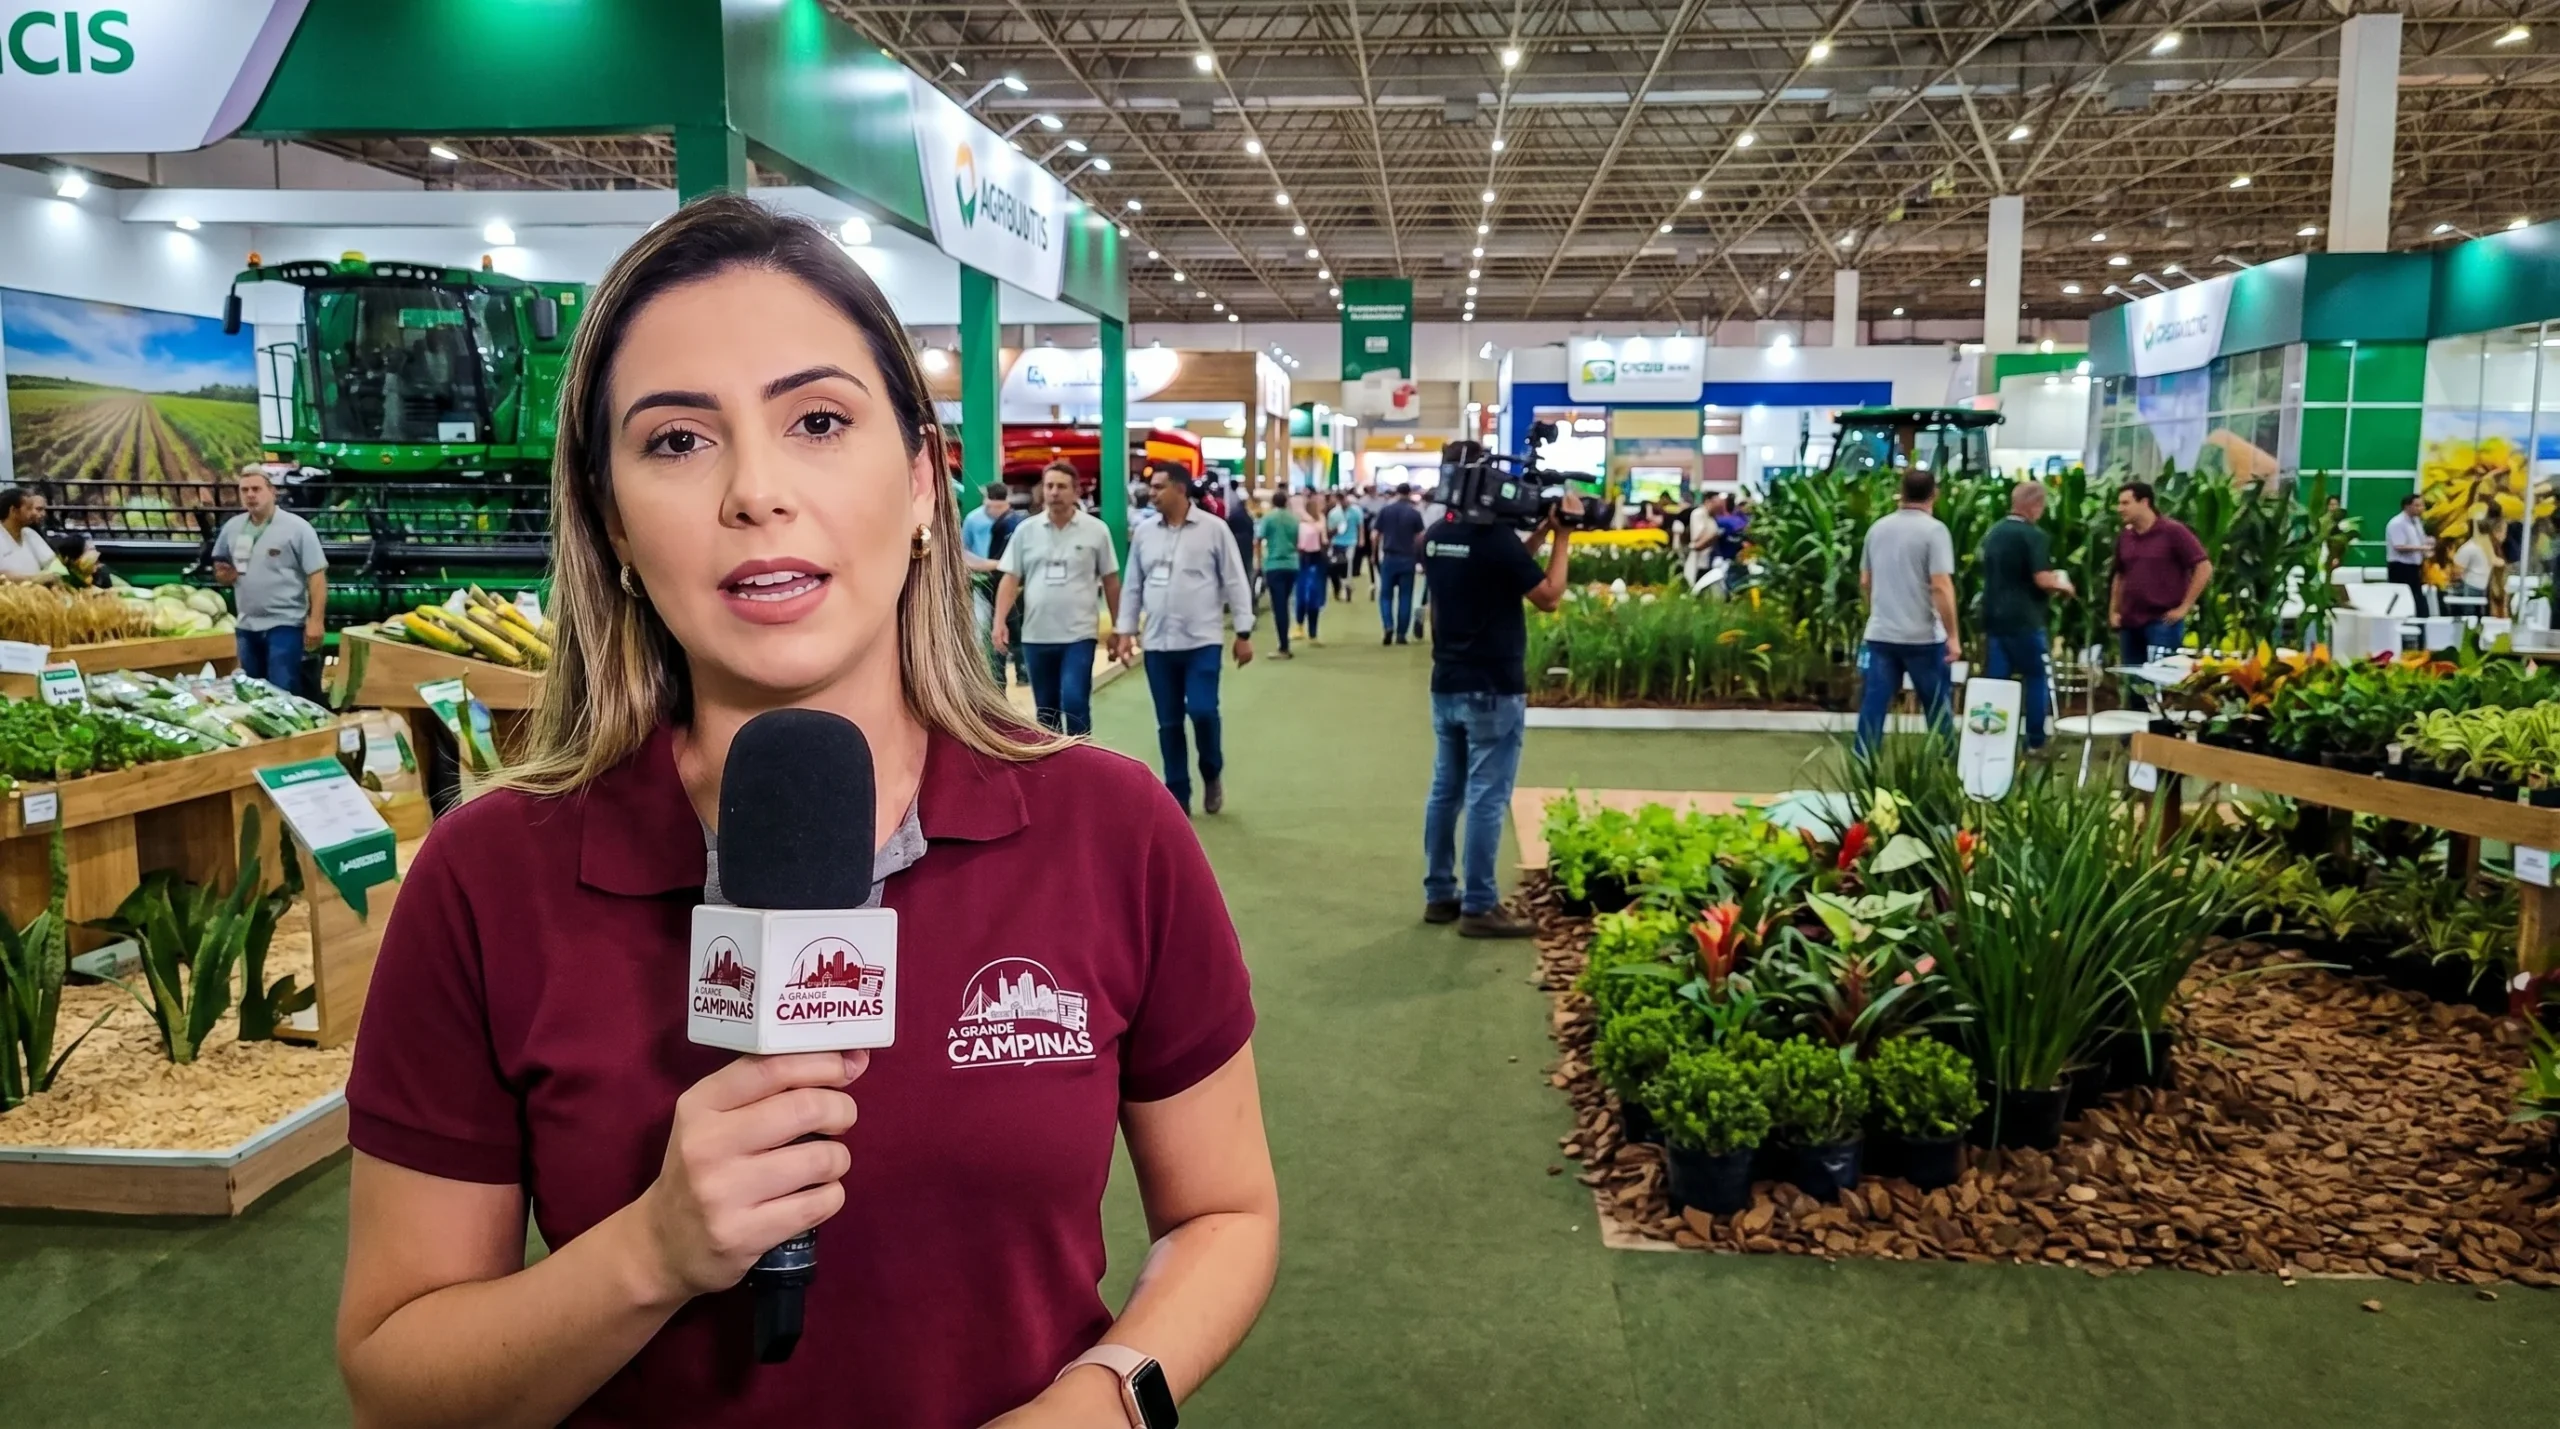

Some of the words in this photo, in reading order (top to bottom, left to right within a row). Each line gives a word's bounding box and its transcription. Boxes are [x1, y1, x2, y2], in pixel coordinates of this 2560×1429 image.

[0, 10, 135, 75] CIS
[693, 995, 754, 1020] CAMPINAS
[778, 993, 786, 1001] A
[776, 999, 884, 1021] CAMPINAS
[947, 1028, 959, 1039] A
[960, 1021, 1016, 1038] GRANDE
[947, 1031, 1094, 1063] CAMPINAS
